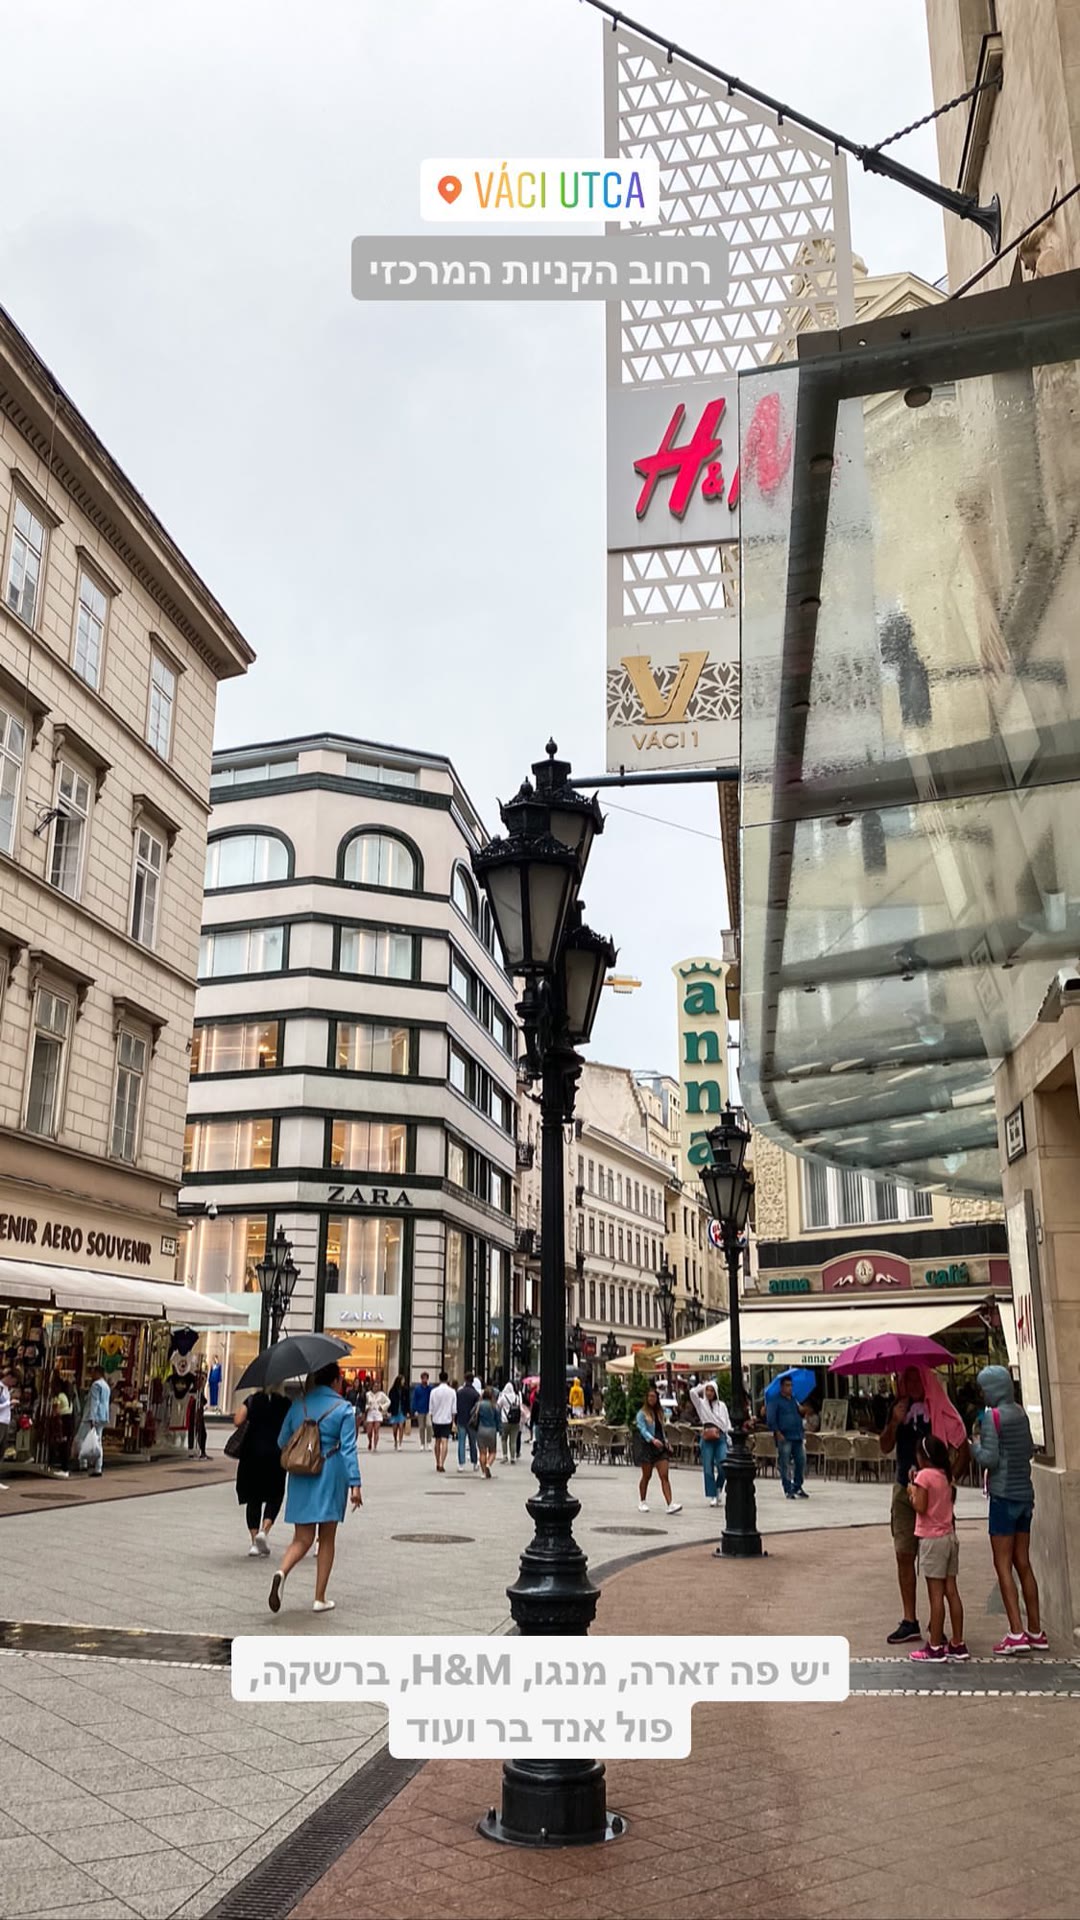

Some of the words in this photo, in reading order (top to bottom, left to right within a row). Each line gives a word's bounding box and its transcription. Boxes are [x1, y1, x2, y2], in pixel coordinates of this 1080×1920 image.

[632, 731, 685, 750] VÁCI
[691, 729, 699, 748] 1
[327, 1186, 413, 1207] ZARA
[41, 1221, 83, 1253] AERO
[86, 1230, 152, 1265] SOUVENIR
[340, 1310, 384, 1323] ZARA
[801, 1354, 826, 1364] anna
